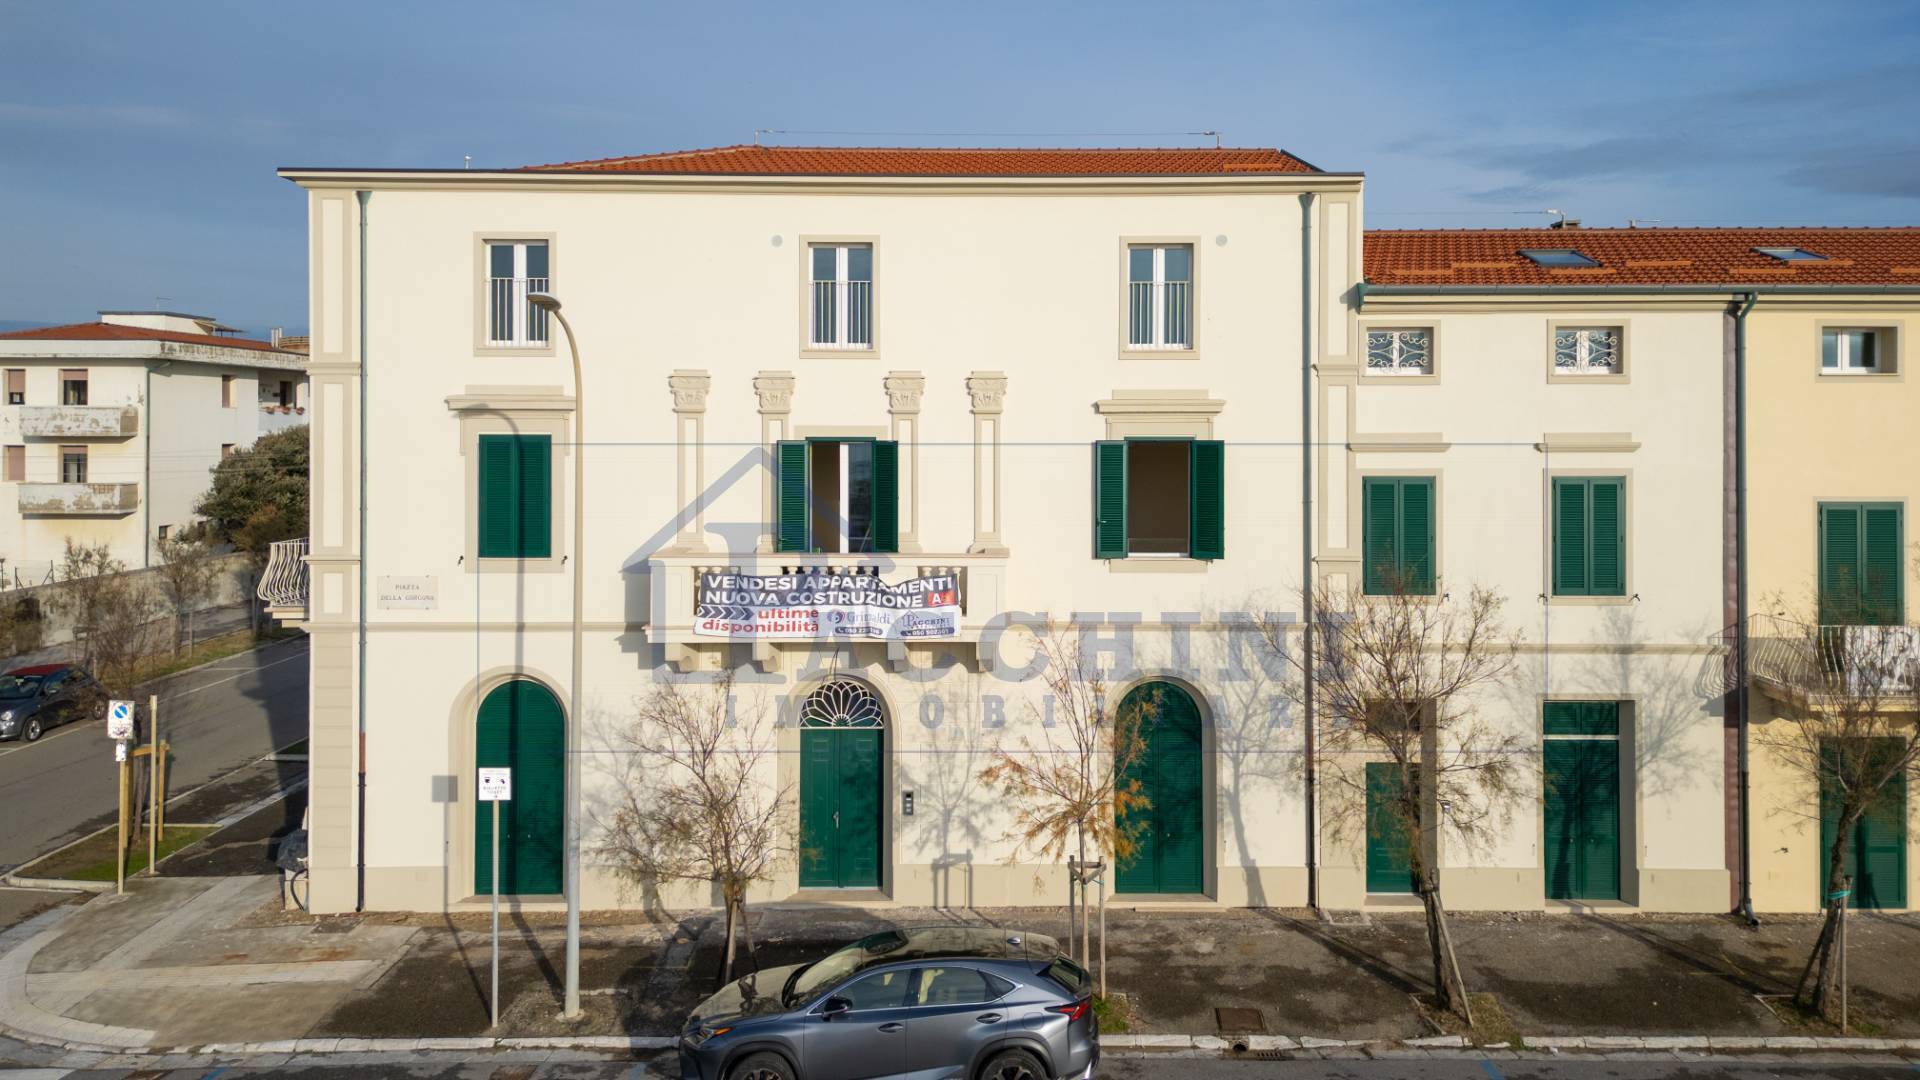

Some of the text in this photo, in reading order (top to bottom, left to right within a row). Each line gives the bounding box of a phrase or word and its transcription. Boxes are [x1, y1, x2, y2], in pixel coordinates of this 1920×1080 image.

[708, 575, 797, 590] VENDESI
[706, 590, 781, 605] NUOVA
[786, 591, 923, 608] COSTRUZIONE
[758, 608, 819, 619] ultime
[702, 619, 819, 633] disponibilità
